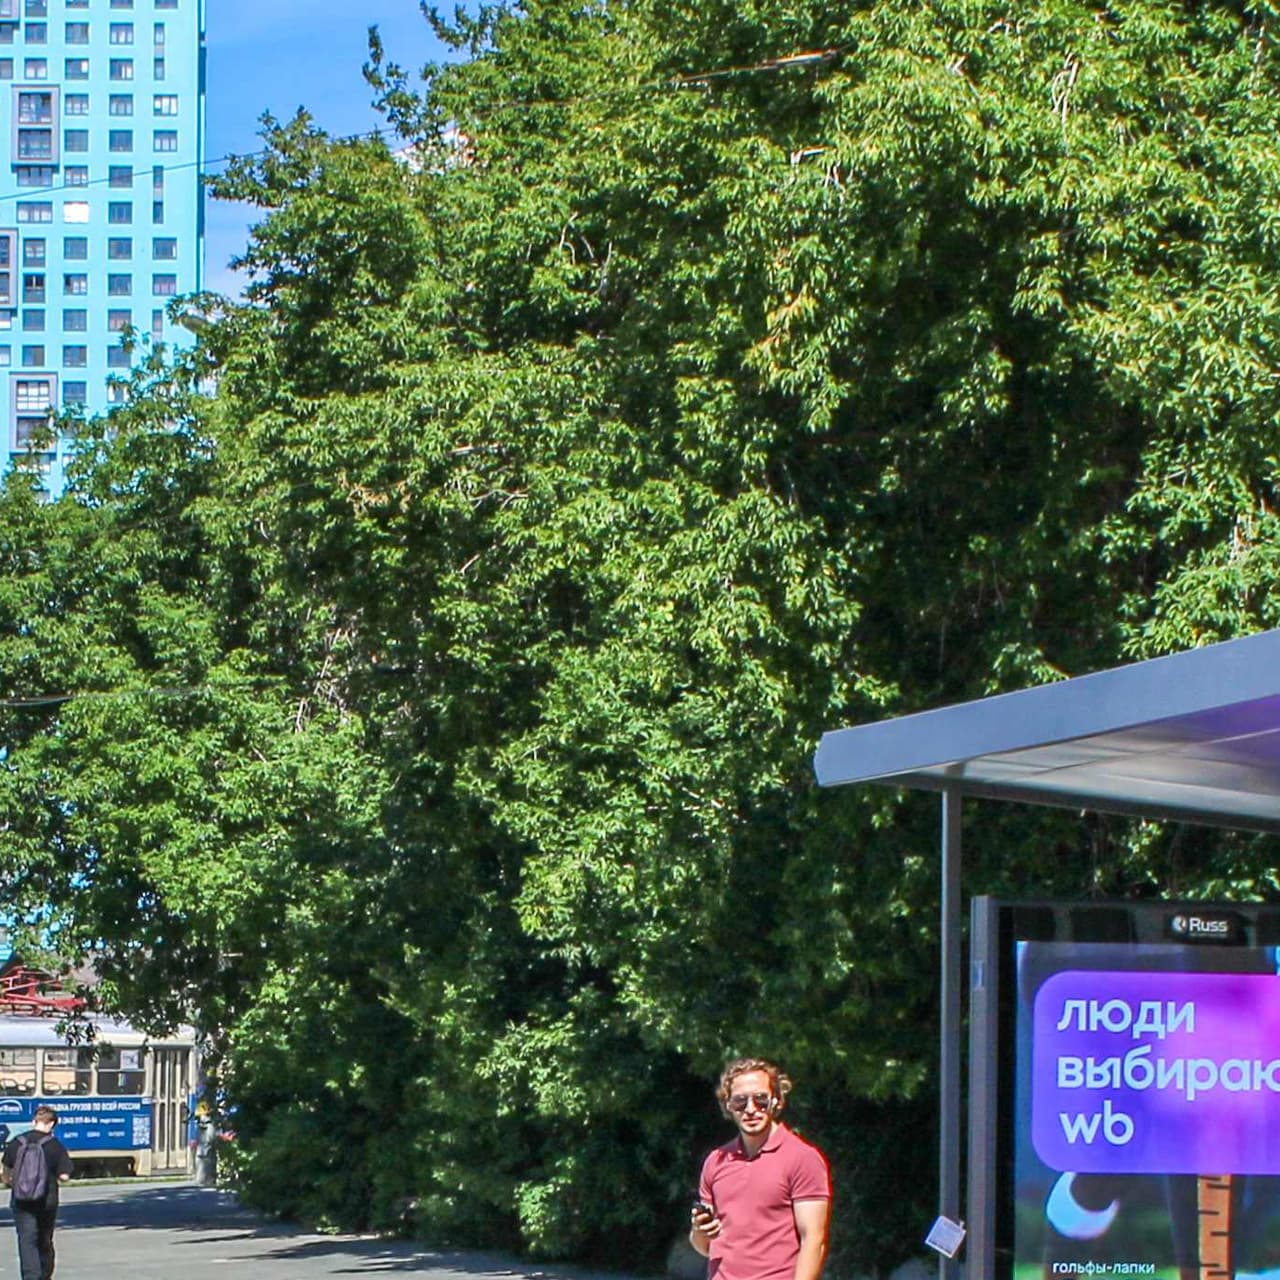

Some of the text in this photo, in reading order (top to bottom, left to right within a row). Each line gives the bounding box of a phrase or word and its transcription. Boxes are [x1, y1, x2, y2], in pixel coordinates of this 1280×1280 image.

[1189, 917, 1228, 932] Russ
[1057, 999, 1195, 1040] люди
[1059, 1100, 1134, 1145] wb
[1053, 1261, 1155, 1277] гольфы-лапки
